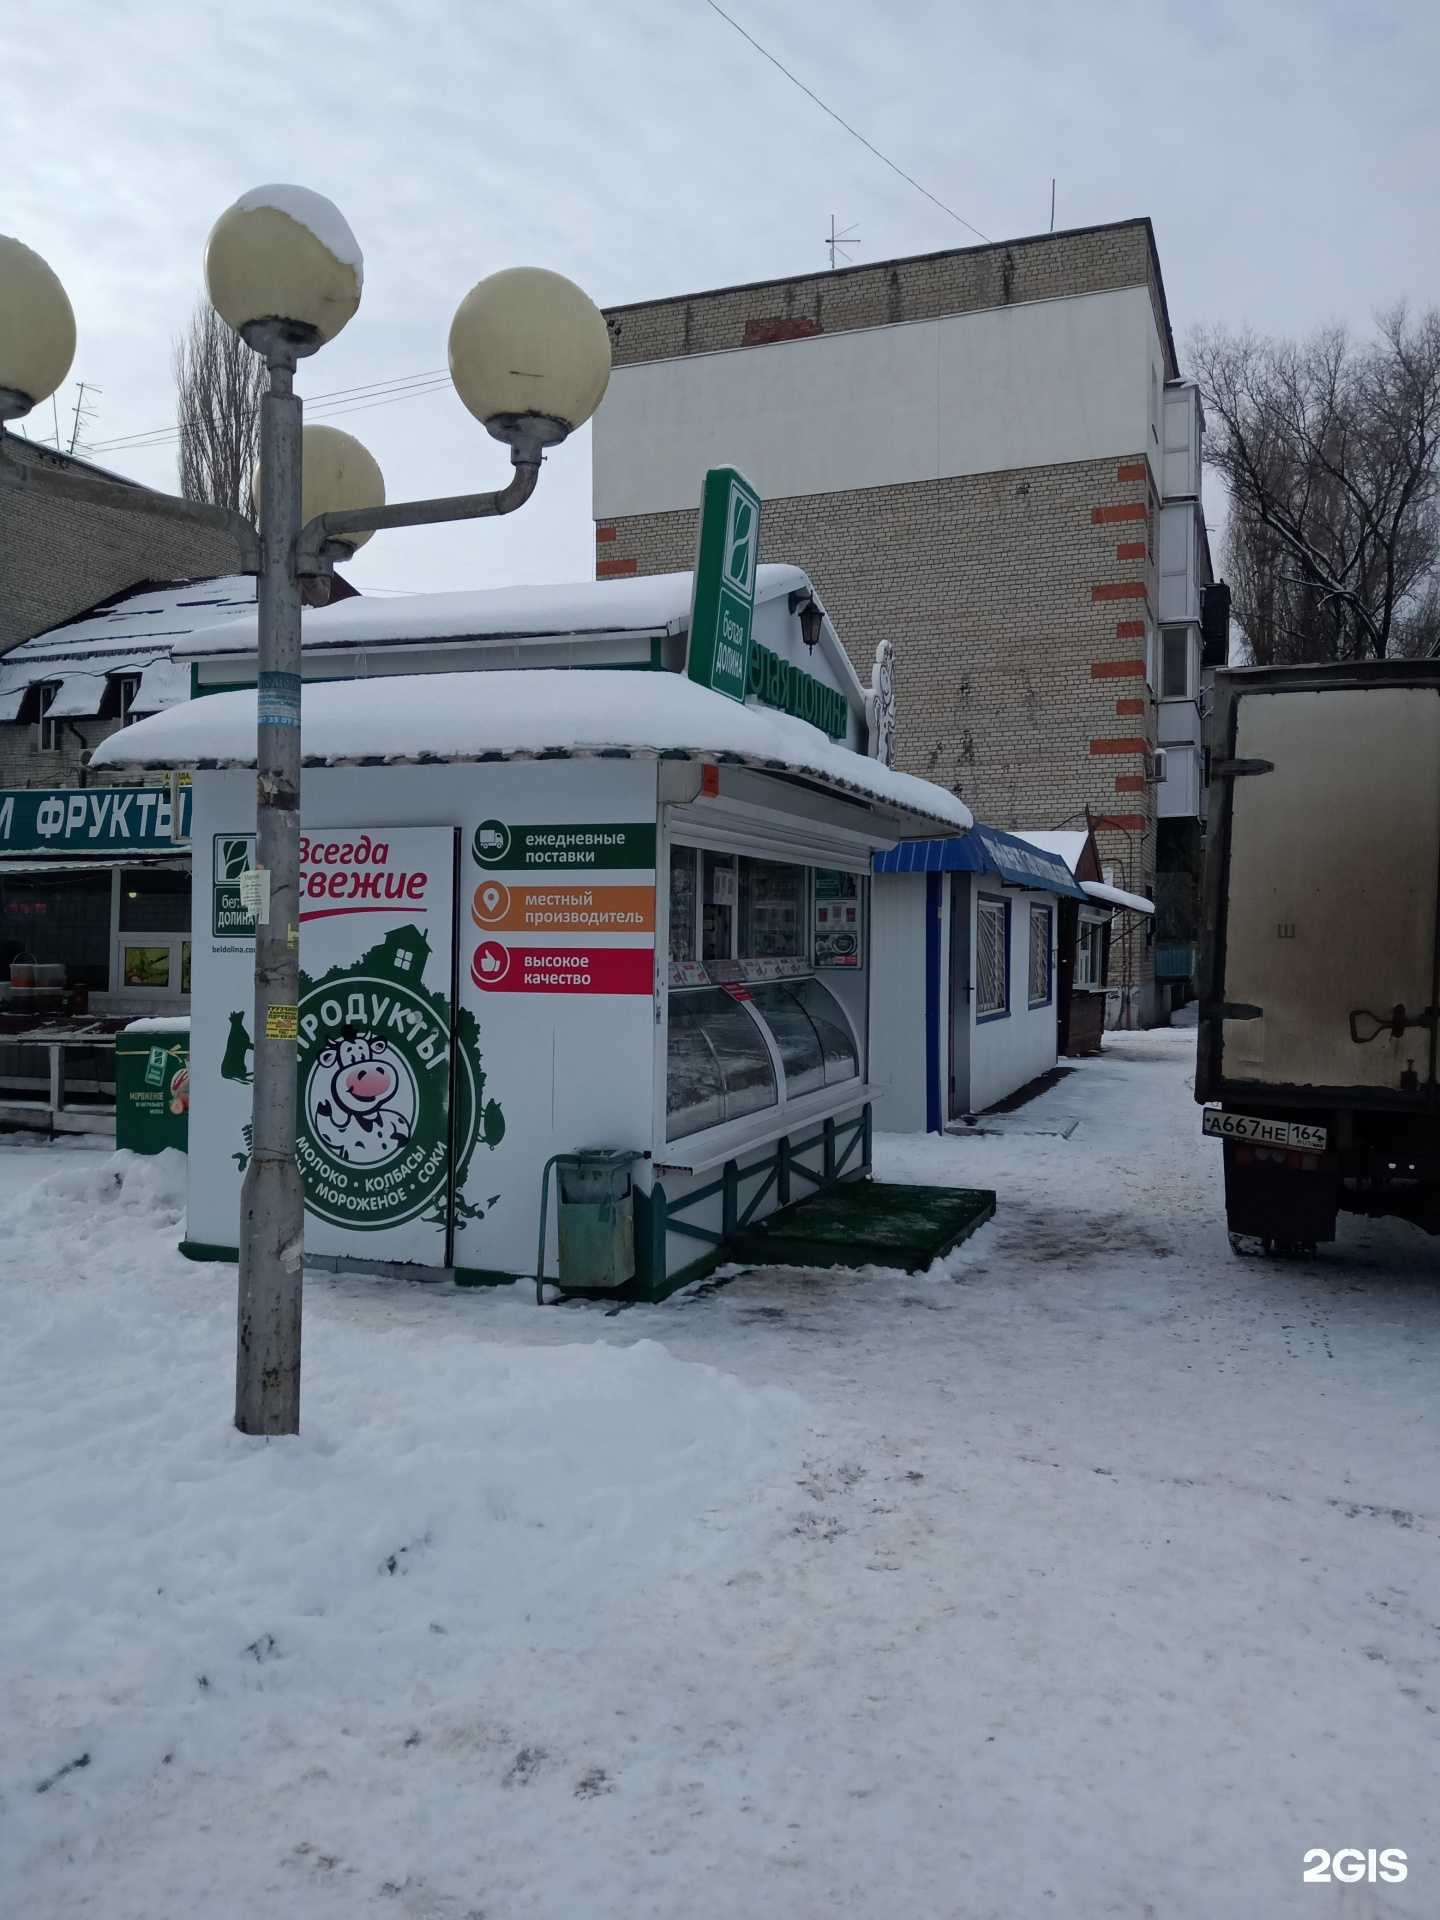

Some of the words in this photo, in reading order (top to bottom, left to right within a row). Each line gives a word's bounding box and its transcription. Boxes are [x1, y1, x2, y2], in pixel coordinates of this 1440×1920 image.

[36, 793, 186, 839] ФРУКТЫ
[525, 833, 626, 848] ежедневные
[525, 851, 596, 863] поставки
[525, 890, 593, 906] местный
[525, 911, 645, 926] производитель
[523, 956, 590, 968] высокое
[523, 973, 592, 986] качество
[1292, 1125, 1325, 1142] 164
[296, 1135, 349, 1188] МОЛОКО
[364, 1144, 428, 1193] КОЛБАСЫ
[315, 1182, 408, 1212] МОРОЖЕНОЕ
[418, 1140, 450, 1184] СОКИ
